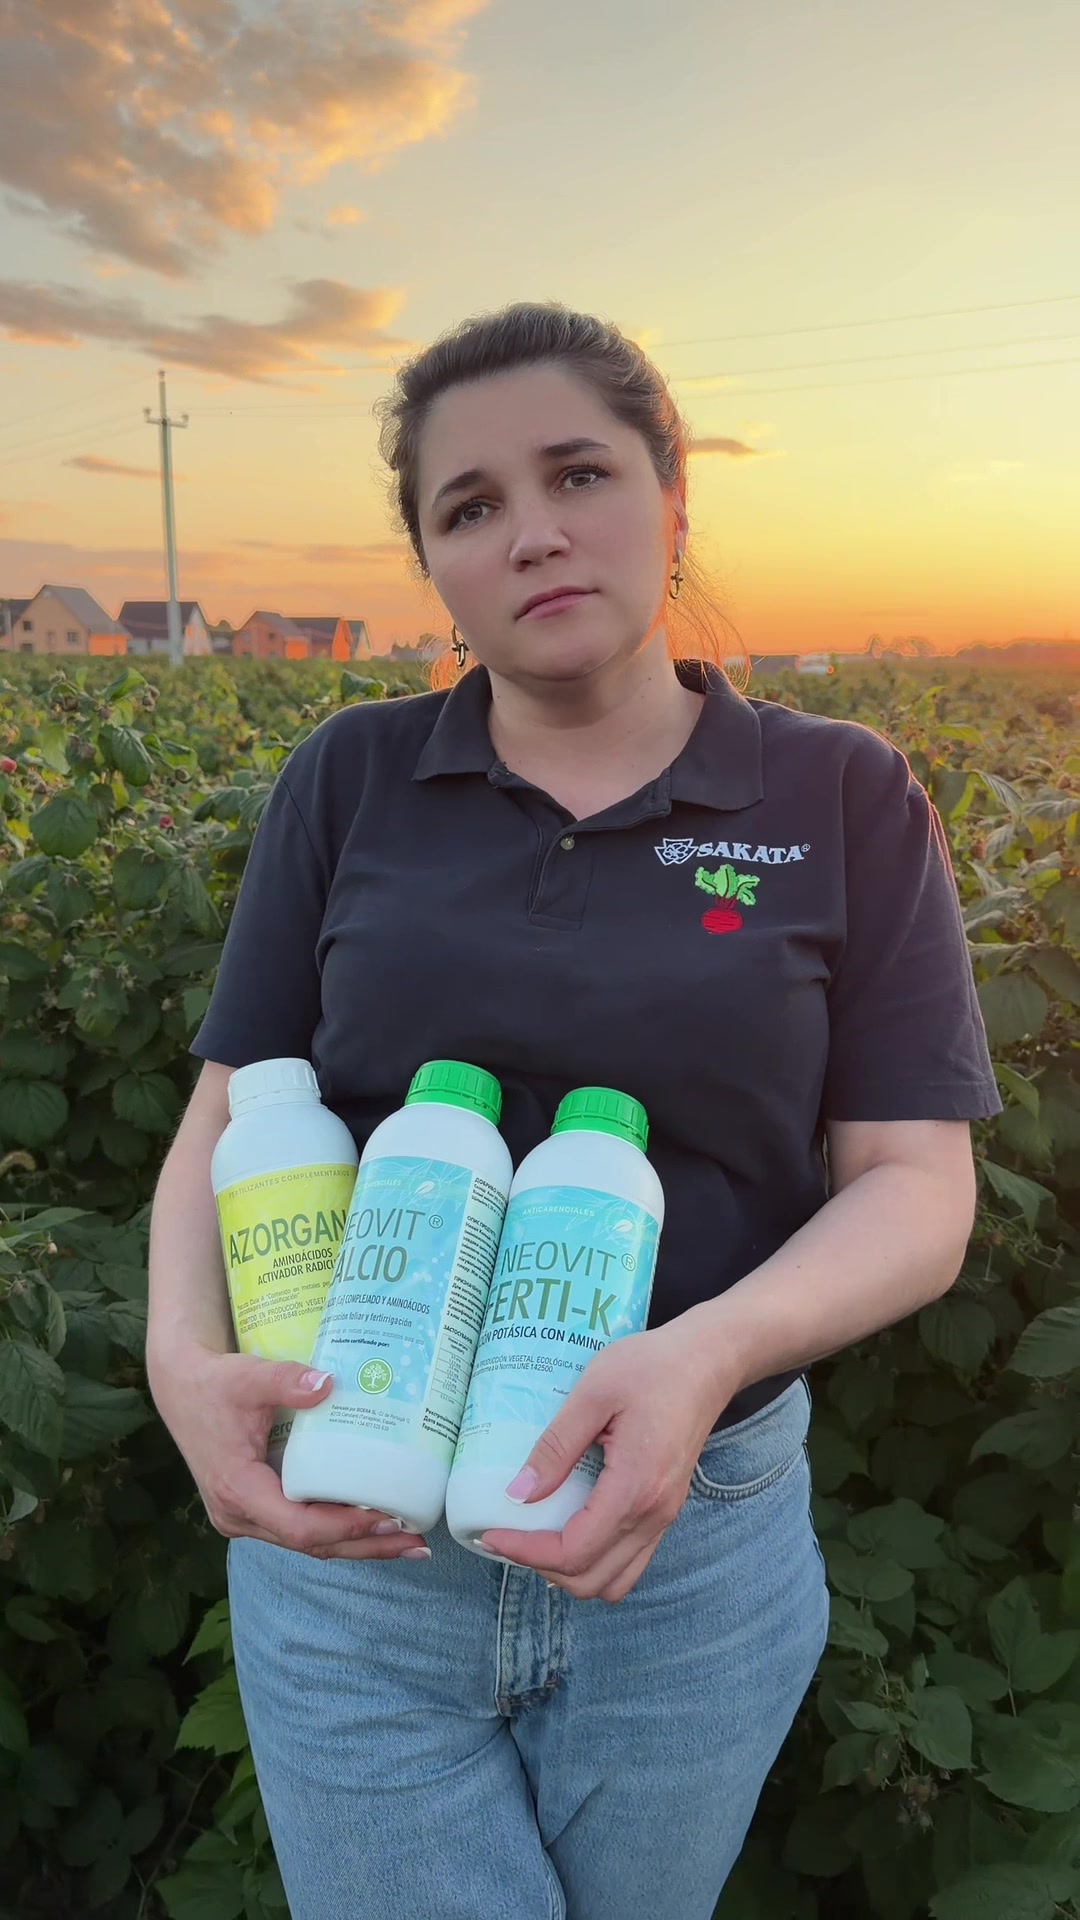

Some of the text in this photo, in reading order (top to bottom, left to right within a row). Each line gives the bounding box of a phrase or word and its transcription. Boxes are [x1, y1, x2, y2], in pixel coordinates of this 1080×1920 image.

[228, 1170, 350, 1199] FERTILIZANTES COMPLEMENTARIOS
[522, 1205, 596, 1217] ANTICARENCIALES
[273, 1247, 333, 1269] AMINOÁCIDOS
[500, 1240, 617, 1282] NEOVIT
[257, 1265, 304, 1286] ACTIVADOR
[386, 1297, 431, 1315] AMINOÁCIDOS
[370, 1313, 412, 1328] fertirrigación
[491, 1323, 537, 1342] POTÁSICA
[540, 1327, 565, 1342] CON
[508, 1354, 534, 1363] VEGETAL
[536, 1356, 573, 1369] ECOLÓGICA
[516, 1362, 529, 1370] UNE
